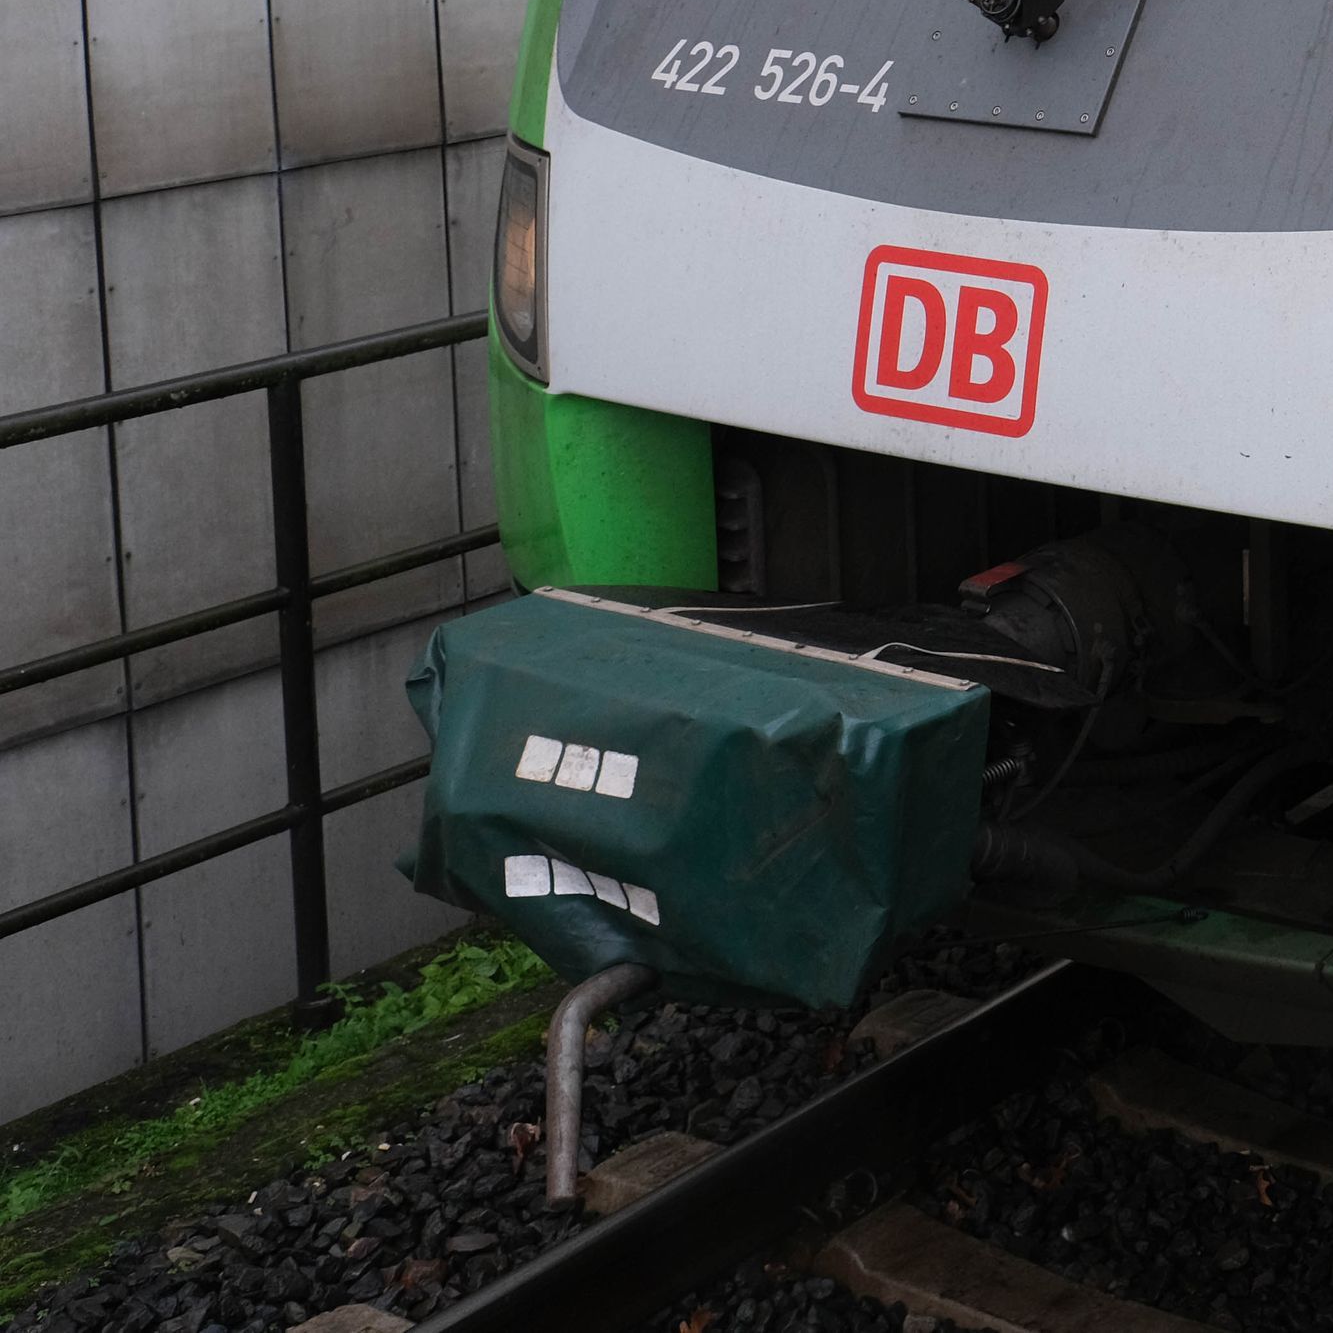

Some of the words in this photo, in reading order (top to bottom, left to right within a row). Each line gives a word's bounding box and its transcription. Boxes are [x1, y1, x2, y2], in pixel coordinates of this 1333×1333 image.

[650, 37, 740, 96] 422
[753, 47, 894, 113] 526-4
[876, 274, 1018, 404] DB
